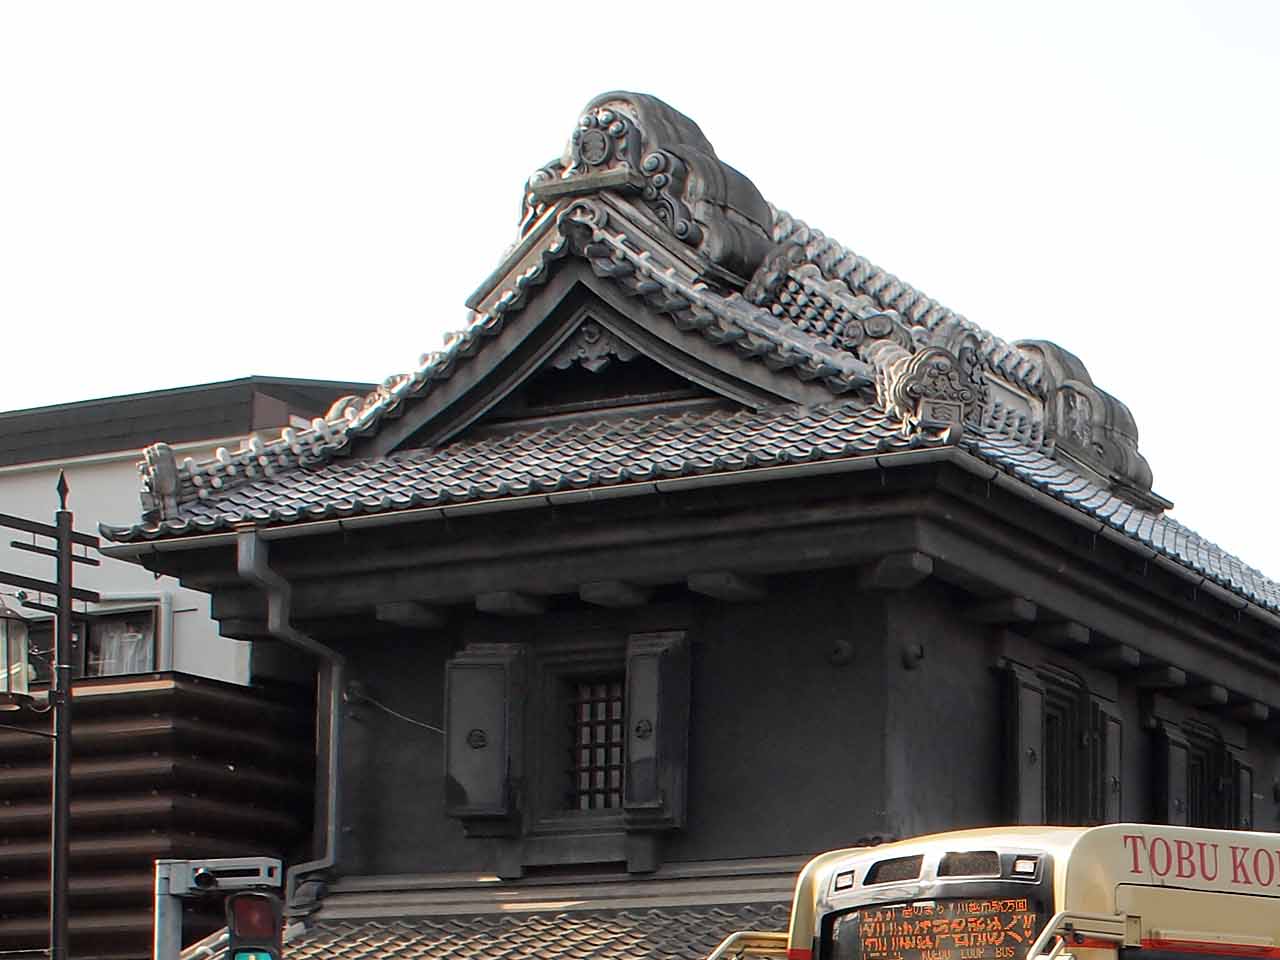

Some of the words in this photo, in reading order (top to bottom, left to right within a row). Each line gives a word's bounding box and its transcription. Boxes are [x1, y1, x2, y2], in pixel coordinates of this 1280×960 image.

[1123, 835, 1218, 881] TOBU
[960, 949, 985, 960] LOOP
[994, 947, 1016, 959] BUS
